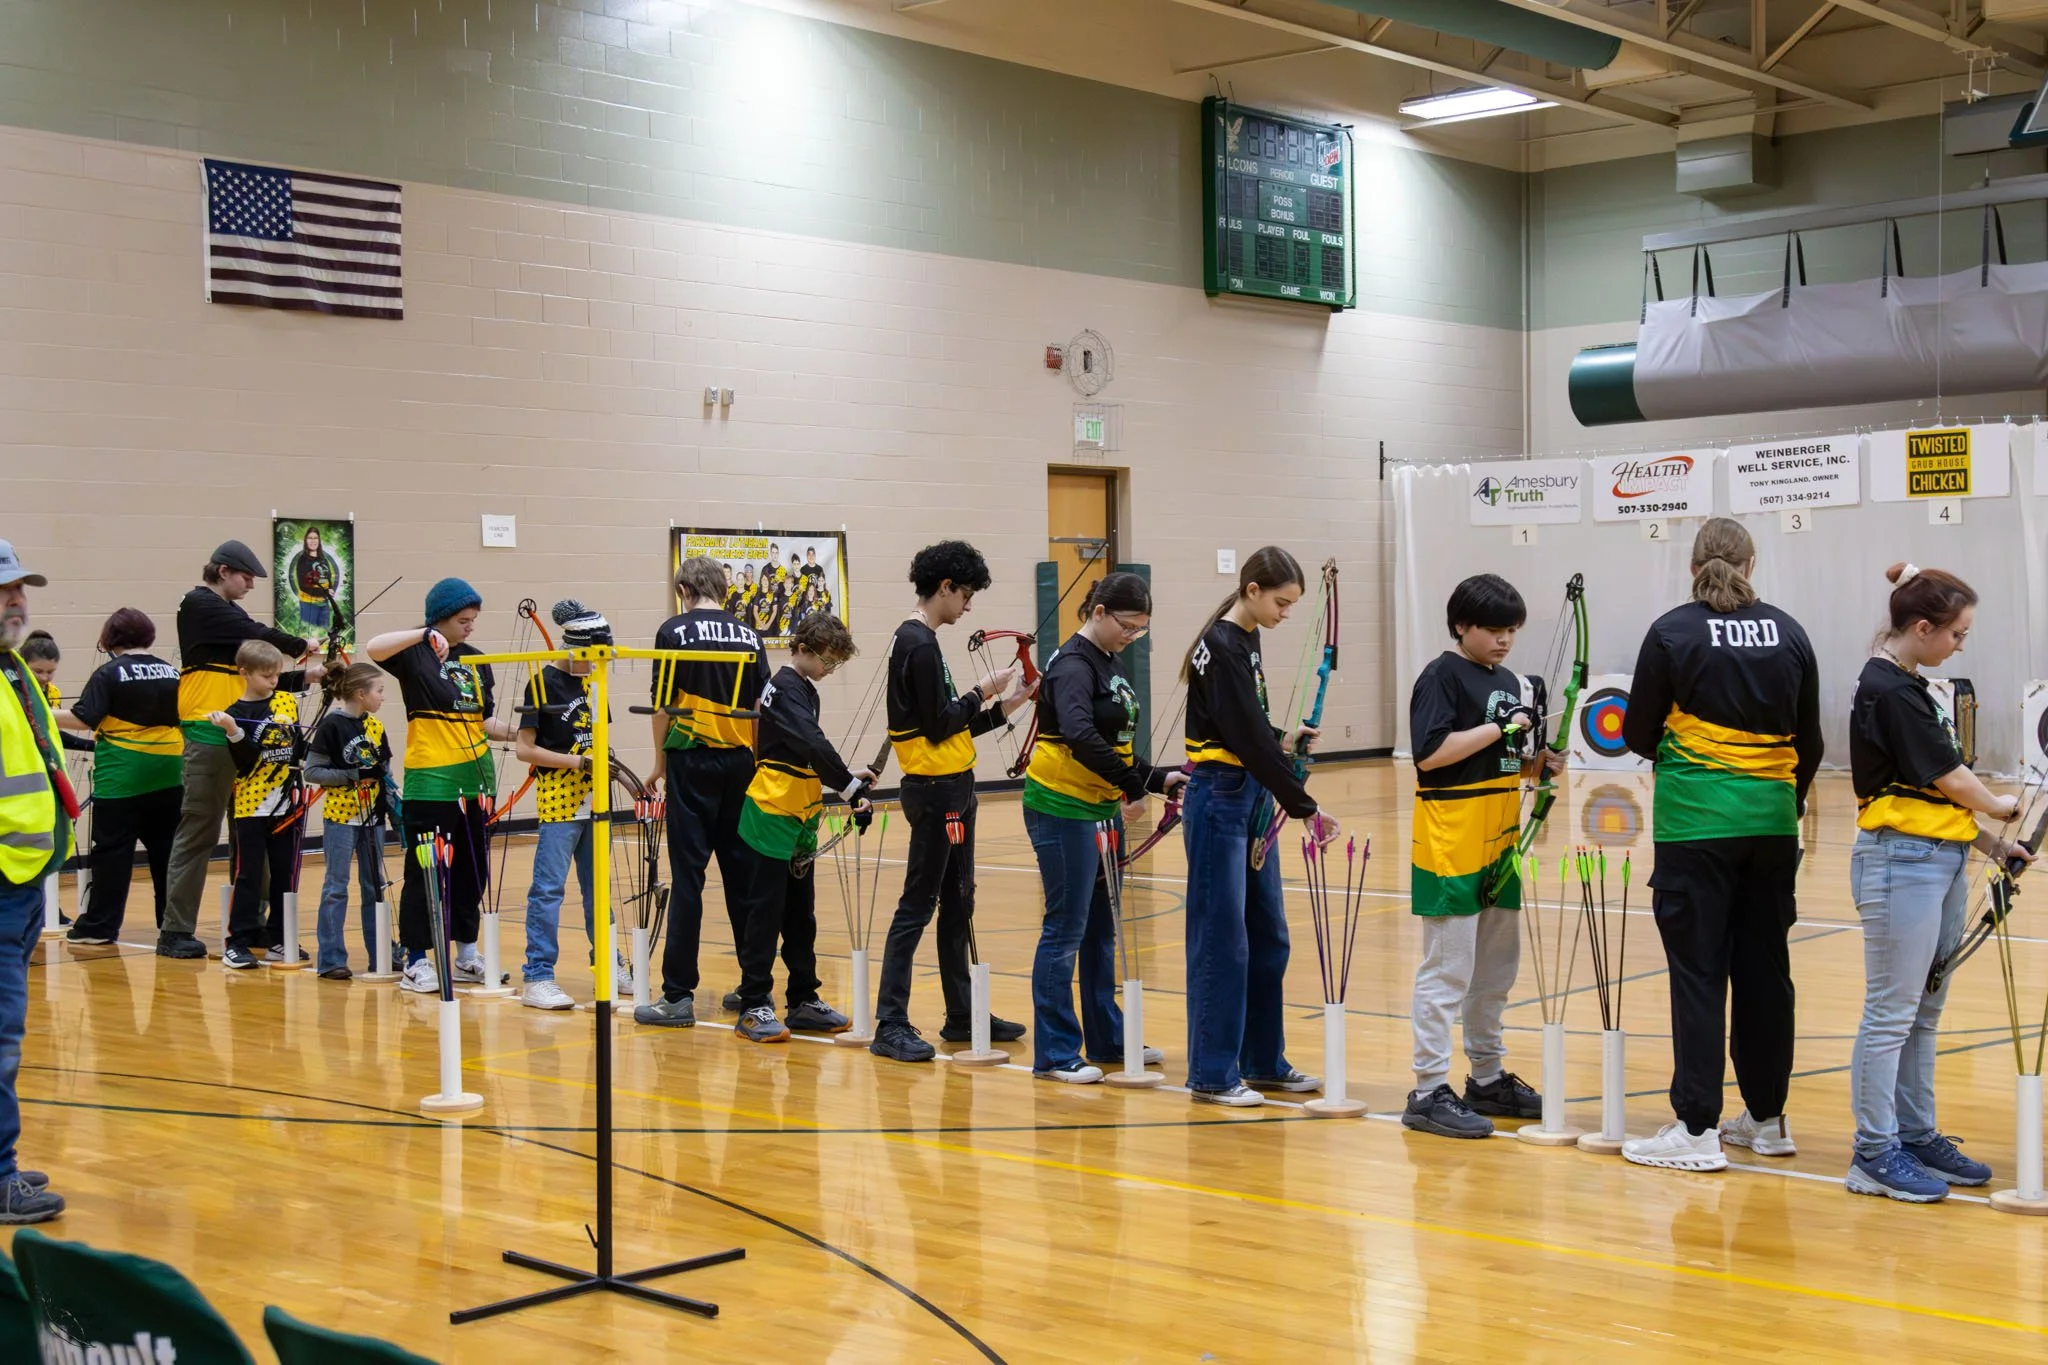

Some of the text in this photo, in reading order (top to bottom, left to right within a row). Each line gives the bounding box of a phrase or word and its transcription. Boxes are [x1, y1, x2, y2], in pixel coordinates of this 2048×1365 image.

[1310, 173, 1338, 189] GUEST
[1273, 195, 1293, 208] POSS
[1271, 208, 1294, 221] BONUS
[1258, 223, 1285, 237] PLAYER
[1293, 229, 1310, 240] FOUL
[1321, 233, 1343, 246] FOULS
[1281, 285, 1300, 296] GAME
[1320, 290, 1336, 301] WON
[1755, 443, 1831, 459] WEINBERGER
[1911, 435, 1966, 455] TWISTED
[1738, 455, 1850, 473] WELL SERVICE, INC.
[1912, 458, 1964, 469] GRUB HOUSE
[1612, 461, 1689, 483] HEALTHY
[1812, 473, 1839, 481] OWNER
[1505, 474, 1578, 489] Amesbury
[1621, 478, 1689, 493] IMPACT
[1912, 472, 1965, 491] CHICKEN
[1504, 489, 1544, 502] Truth
[1759, 491, 1831, 506] (507) 334-9214
[1618, 502, 1688, 514] 507-330-2940
[1939, 506, 1950, 521] 4
[1791, 514, 1802, 530] 3
[1521, 530, 1528, 543] 1
[1649, 524, 1660, 538] 2
[674, 620, 761, 650] T. MILLER
[1707, 618, 1780, 647] FORD
[119, 665, 133, 682] A.
